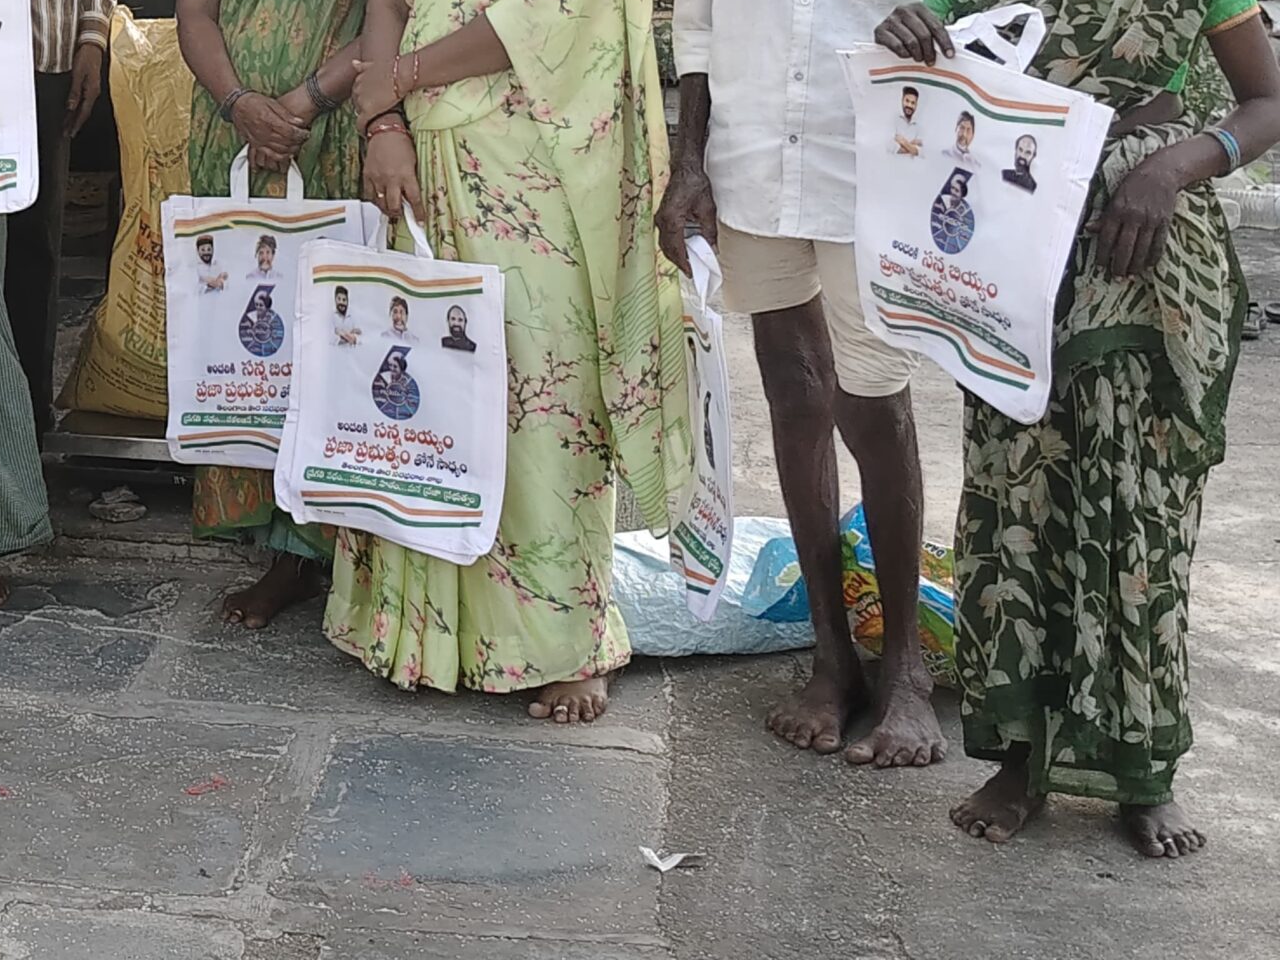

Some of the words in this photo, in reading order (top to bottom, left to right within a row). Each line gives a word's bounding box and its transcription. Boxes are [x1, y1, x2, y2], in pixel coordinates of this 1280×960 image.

[922, 250, 947, 282] సన్న
[241, 360, 268, 381] సన్న
[196, 380, 222, 402] ప్రజా
[225, 381, 277, 404] ప్రభుత్వం
[374, 423, 402, 446] సన్న
[404, 428, 454, 455] బియ్యం
[323, 437, 353, 458] ప్రజా
[354, 442, 411, 469] ప్రభుత్వం
[437, 459, 468, 477] సాధ్యం
